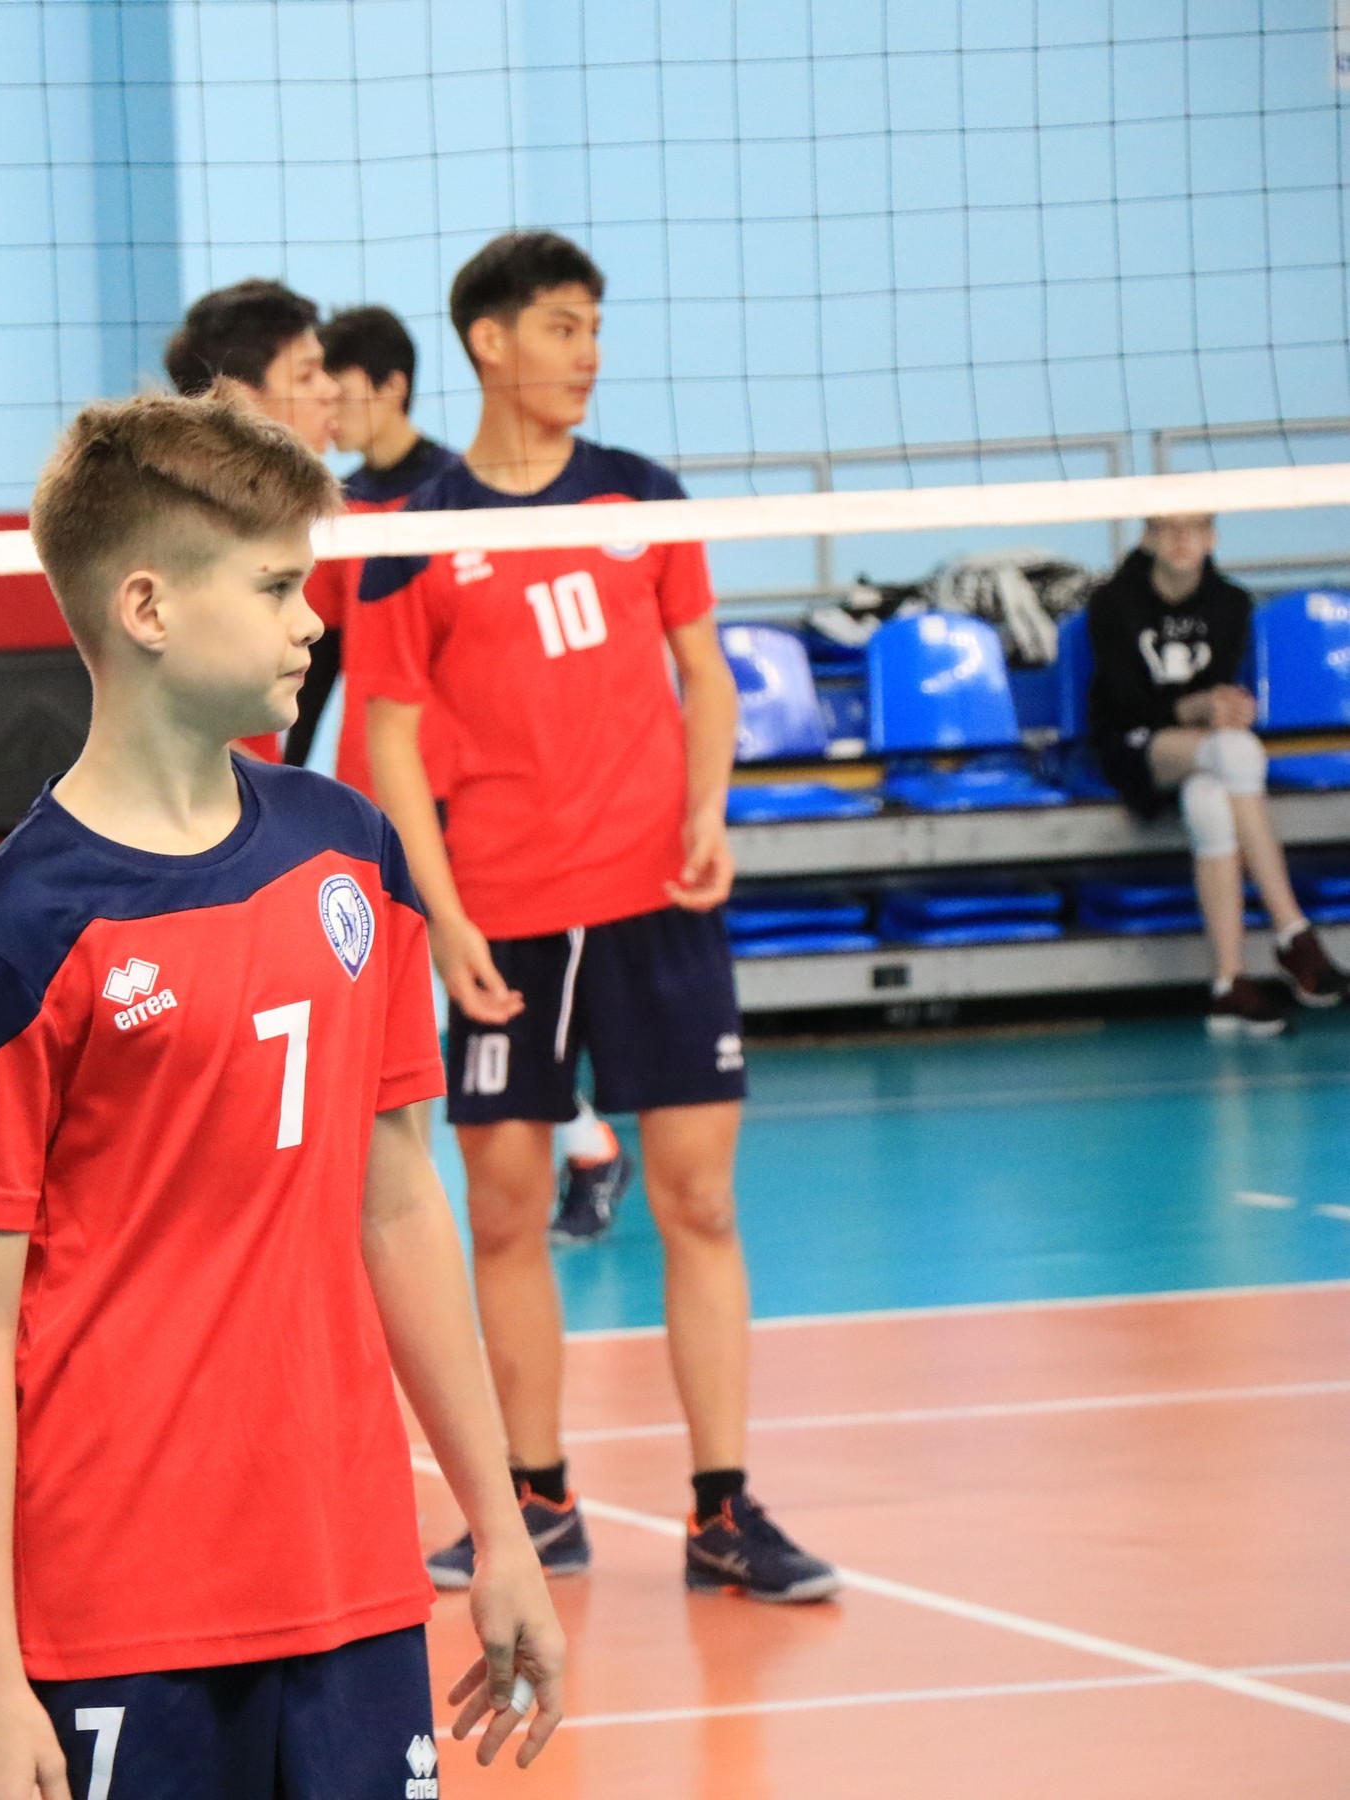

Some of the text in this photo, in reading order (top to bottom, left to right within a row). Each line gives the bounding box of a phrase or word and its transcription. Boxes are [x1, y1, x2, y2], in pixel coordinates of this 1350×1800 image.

[524, 570, 608, 660] 10
[253, 999, 312, 1150] 7
[462, 1033, 510, 1096] 10
[75, 1706, 125, 1800] 7
